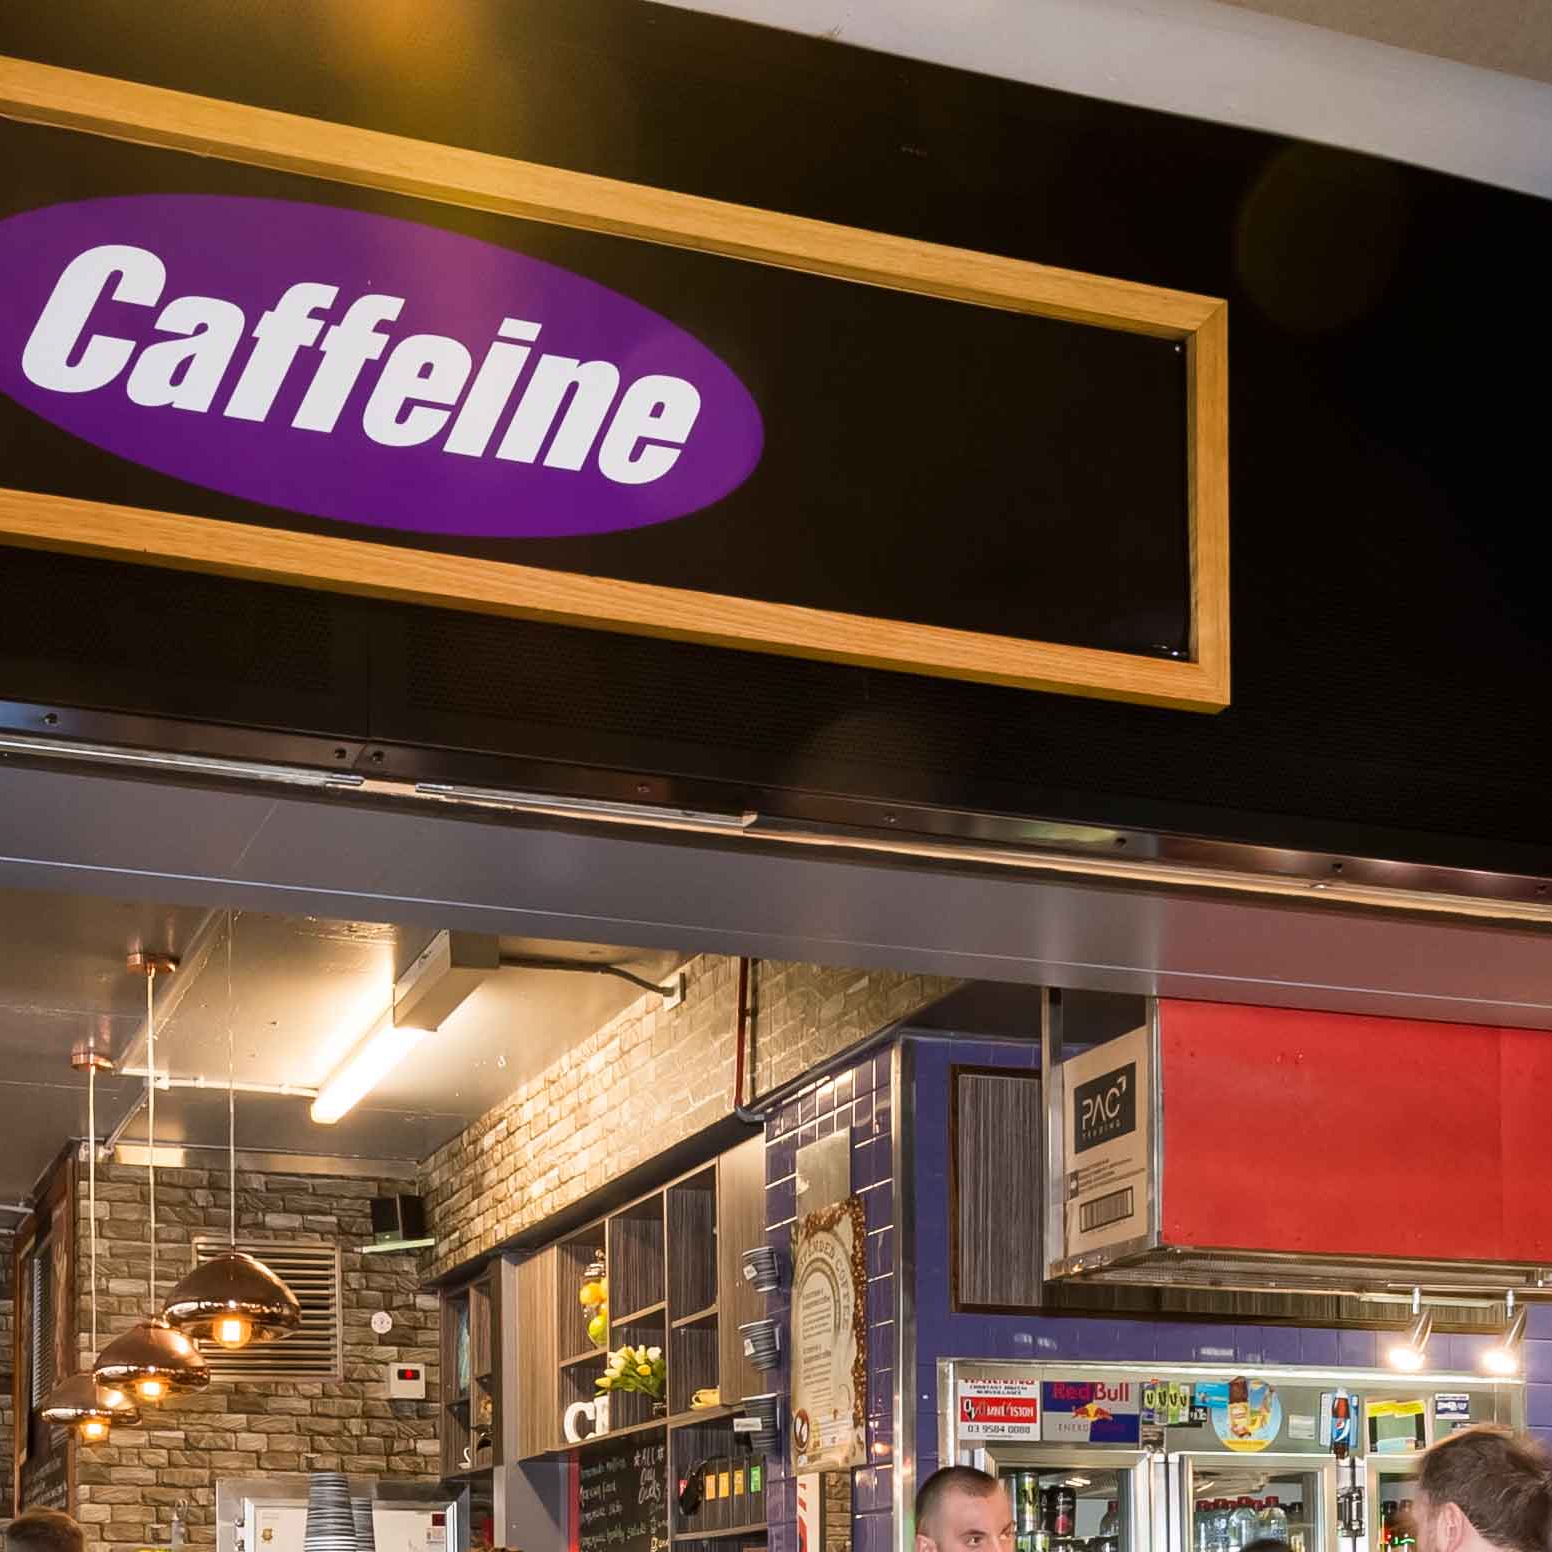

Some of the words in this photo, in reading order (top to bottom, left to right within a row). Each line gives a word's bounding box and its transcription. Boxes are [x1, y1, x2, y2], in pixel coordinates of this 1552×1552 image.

[20, 243, 701, 485] Caffeine
[1054, 1383, 1092, 1400] Red
[1094, 1383, 1129, 1402] Bull
